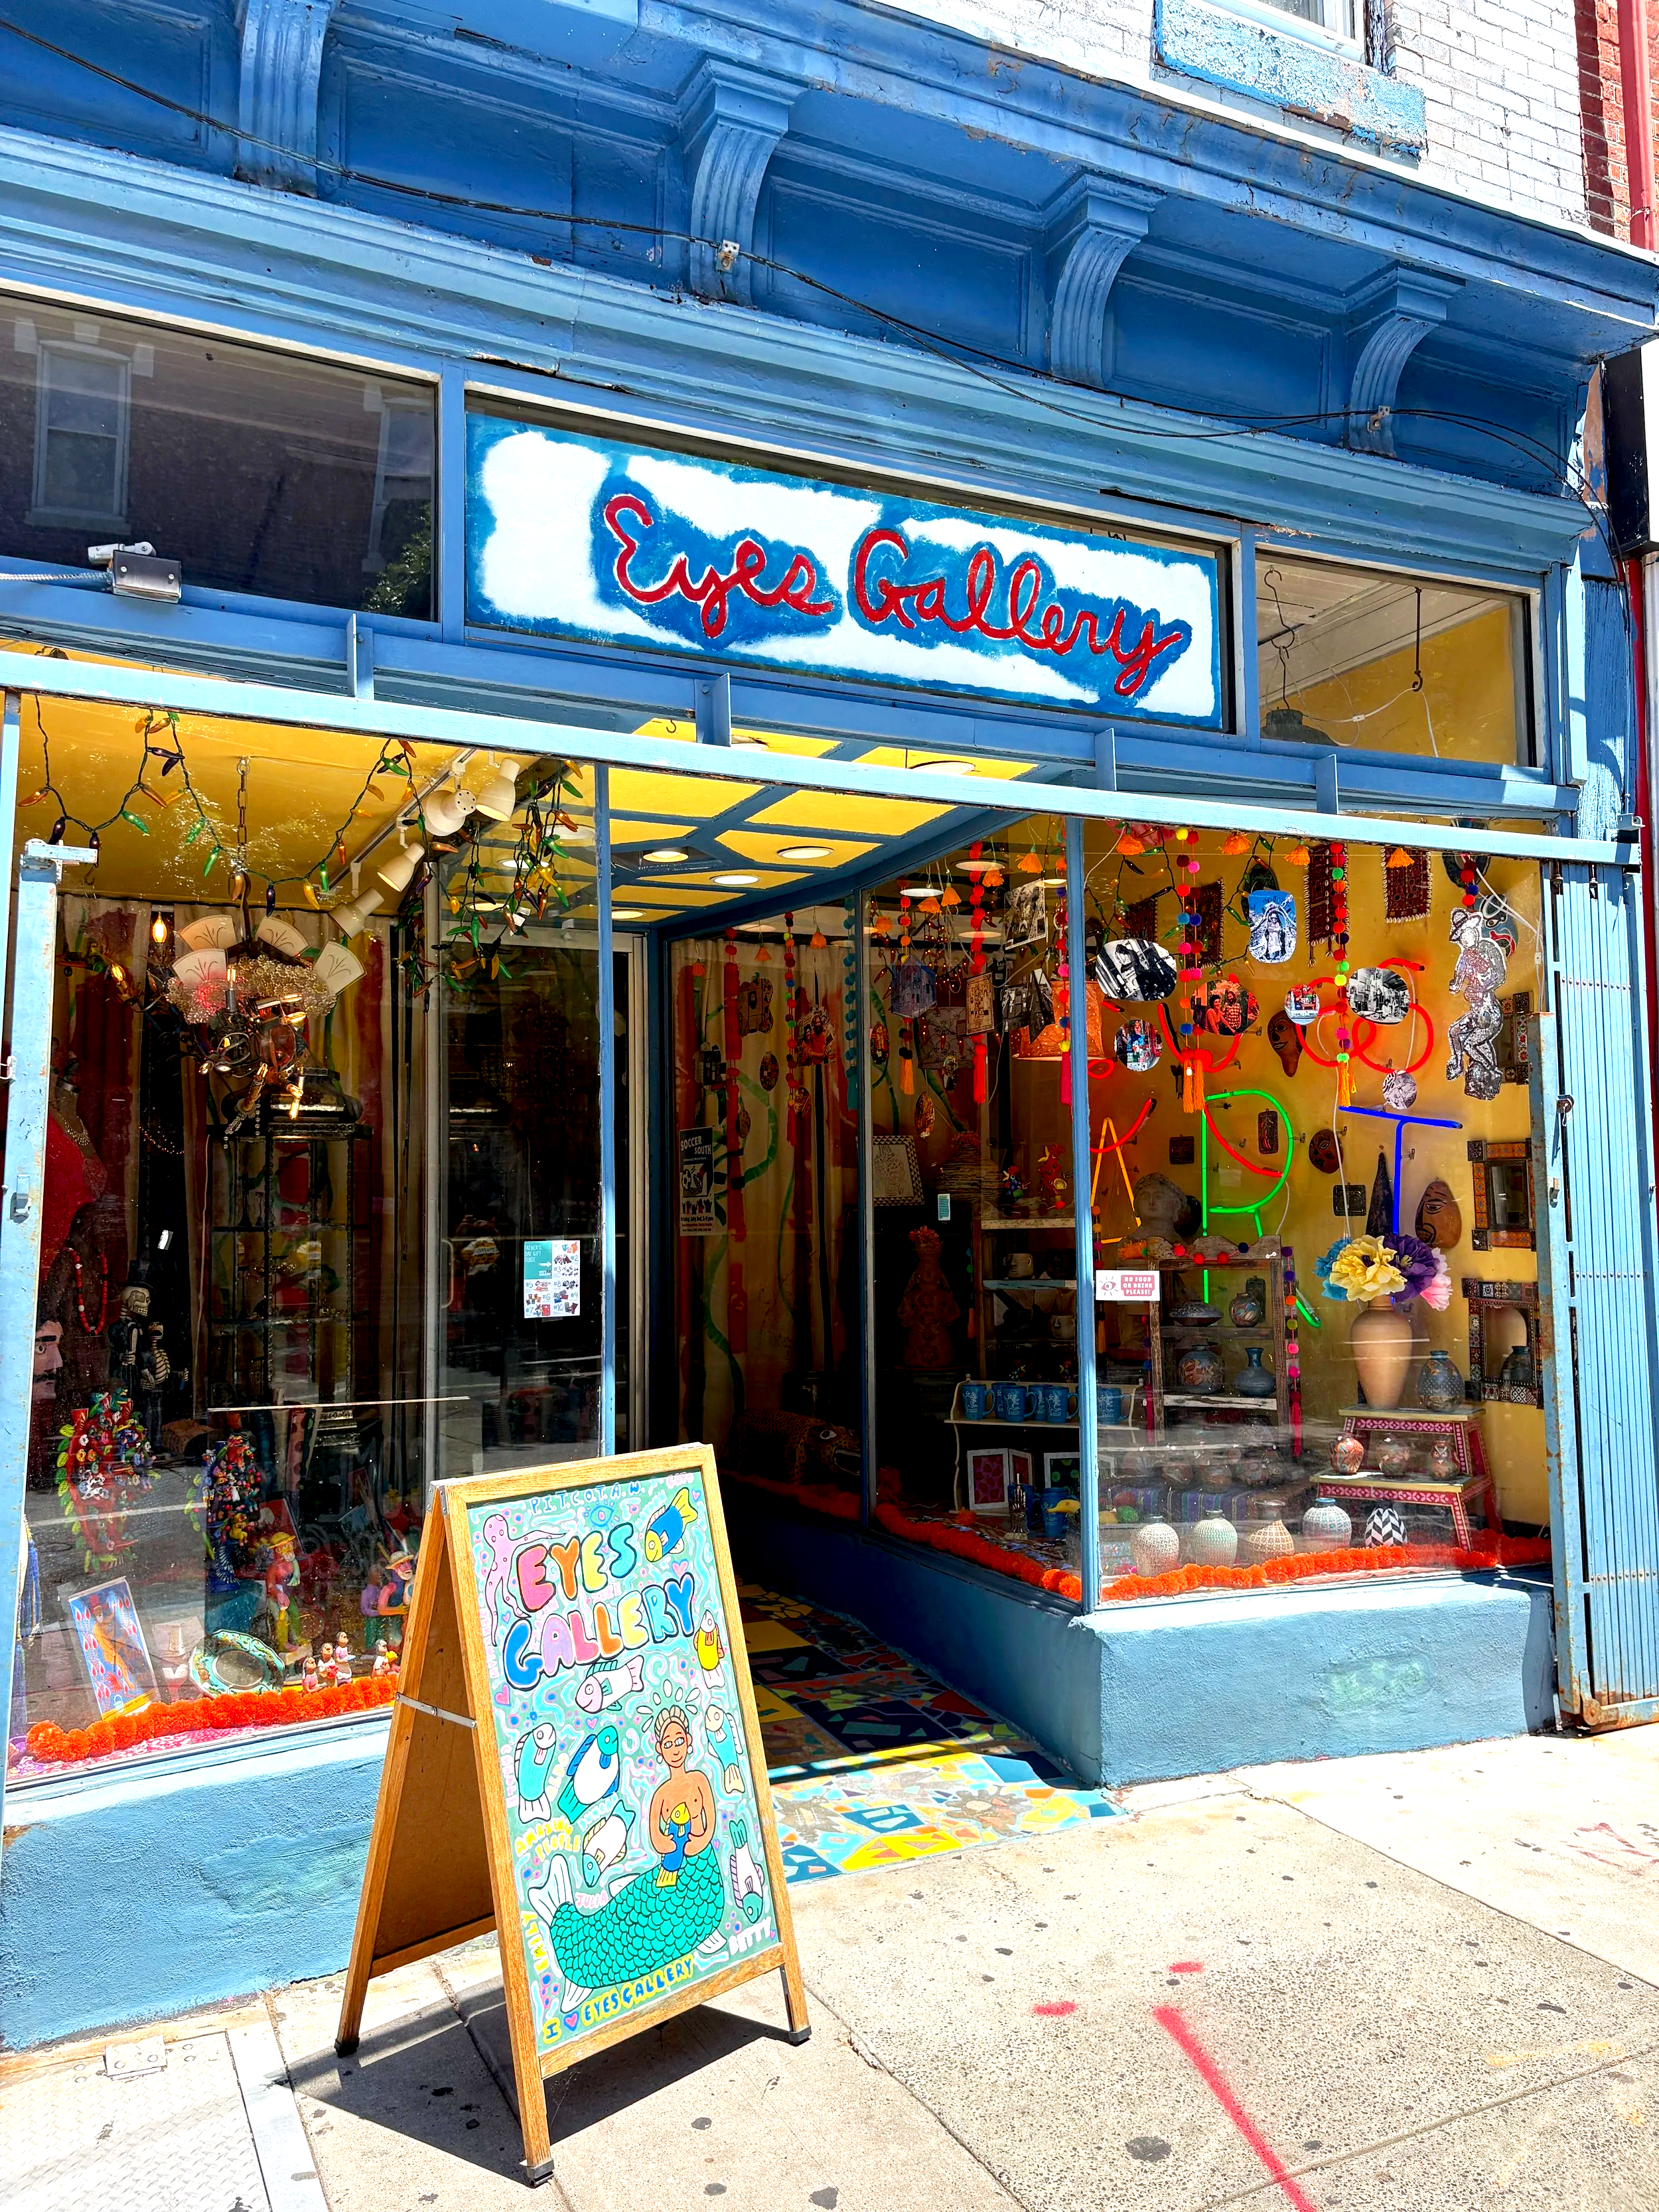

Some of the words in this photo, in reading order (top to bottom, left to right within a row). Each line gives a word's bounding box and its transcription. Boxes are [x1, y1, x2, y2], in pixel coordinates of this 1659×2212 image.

[603, 494, 833, 639] Eyes
[847, 528, 1183, 698] Gallery
[681, 1136, 702, 1151] SOCCER
[695, 1145, 711, 1155] SOUTH
[516, 1522, 637, 1613] EYES
[502, 1572, 695, 1692] GALLERY
[545, 1752, 570, 1802] ALDO
[534, 1832, 581, 1863] PEOPLE
[575, 1890, 609, 1909] JULIA
[728, 1915, 772, 1956] BETTY
[544, 2019, 560, 2043] I
